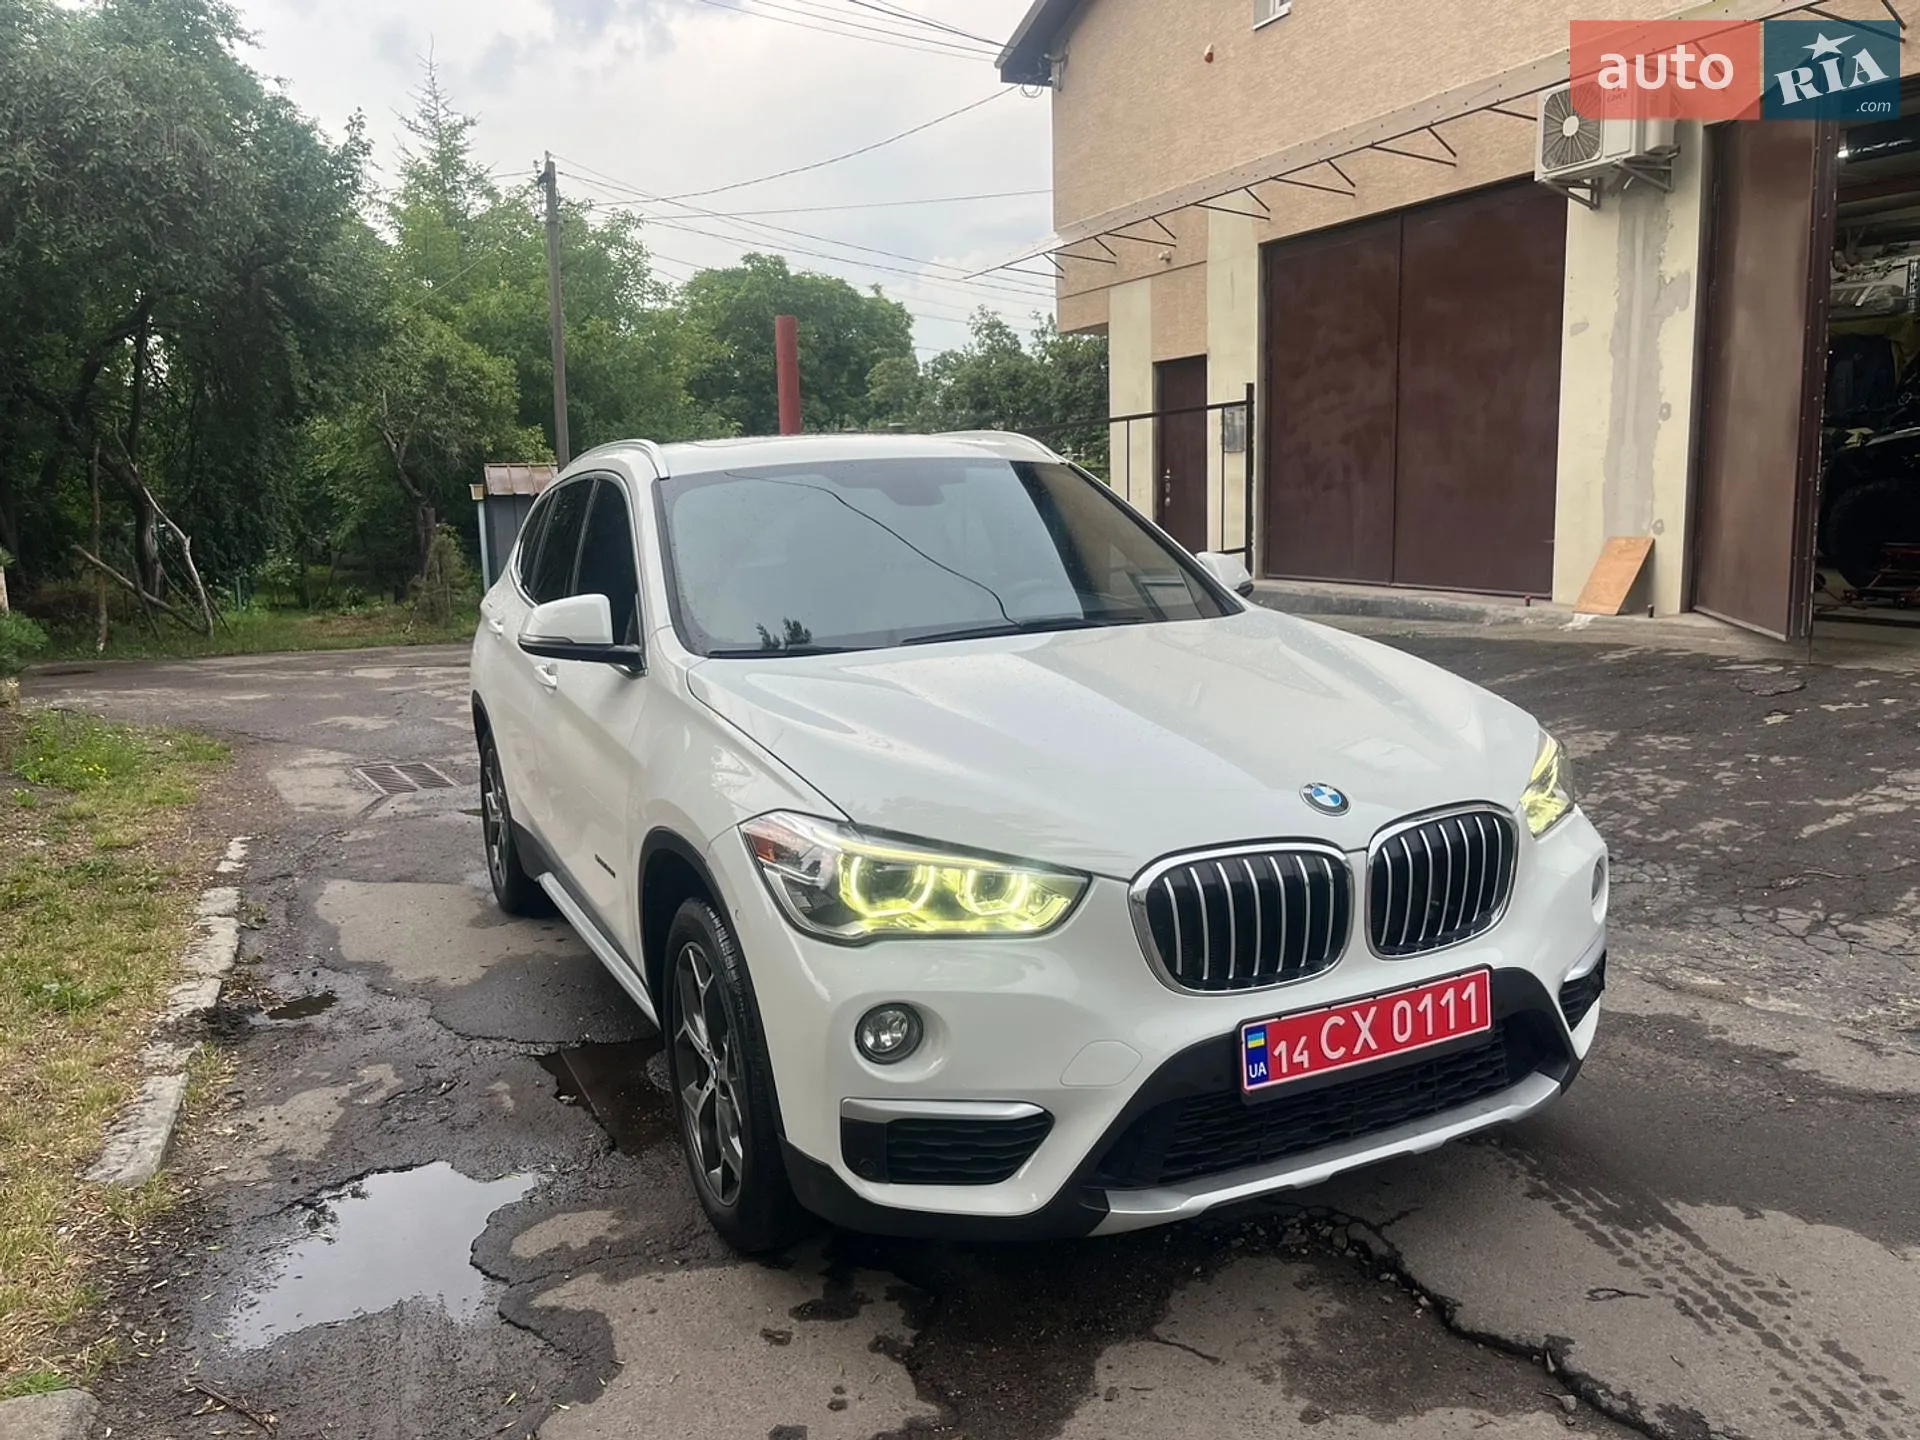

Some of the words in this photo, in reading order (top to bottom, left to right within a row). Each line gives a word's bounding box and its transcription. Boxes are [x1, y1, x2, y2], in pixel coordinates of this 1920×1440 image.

[1272, 1035, 1310, 1073] 14
[1320, 1006, 1378, 1060] CX
[1392, 981, 1478, 1043] 0111
[1249, 1061, 1267, 1079] UA
